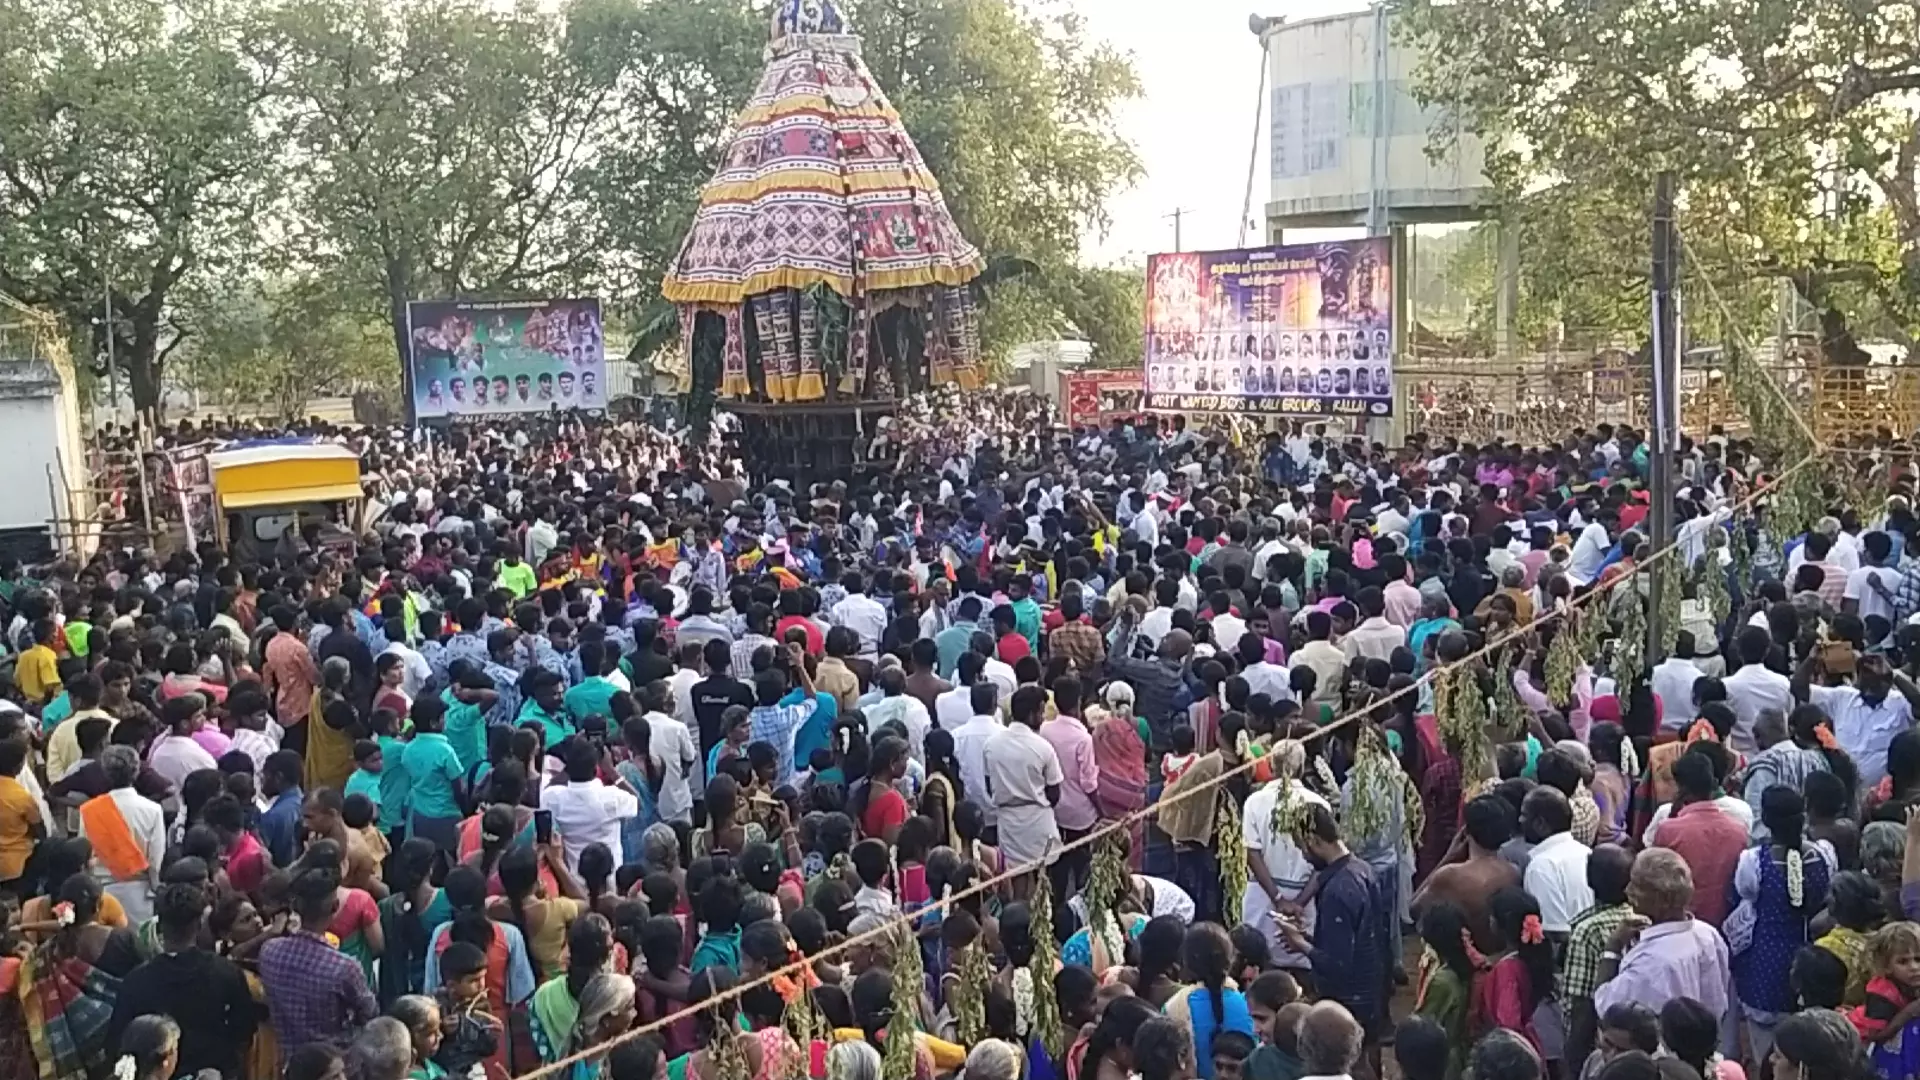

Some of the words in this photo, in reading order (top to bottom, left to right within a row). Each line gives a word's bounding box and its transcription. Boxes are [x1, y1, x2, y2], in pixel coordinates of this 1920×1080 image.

[1152, 394, 1178, 407] MOST
[1219, 396, 1246, 410] BOYS
[1250, 400, 1257, 410] &
[1282, 397, 1321, 412] GROUPS
